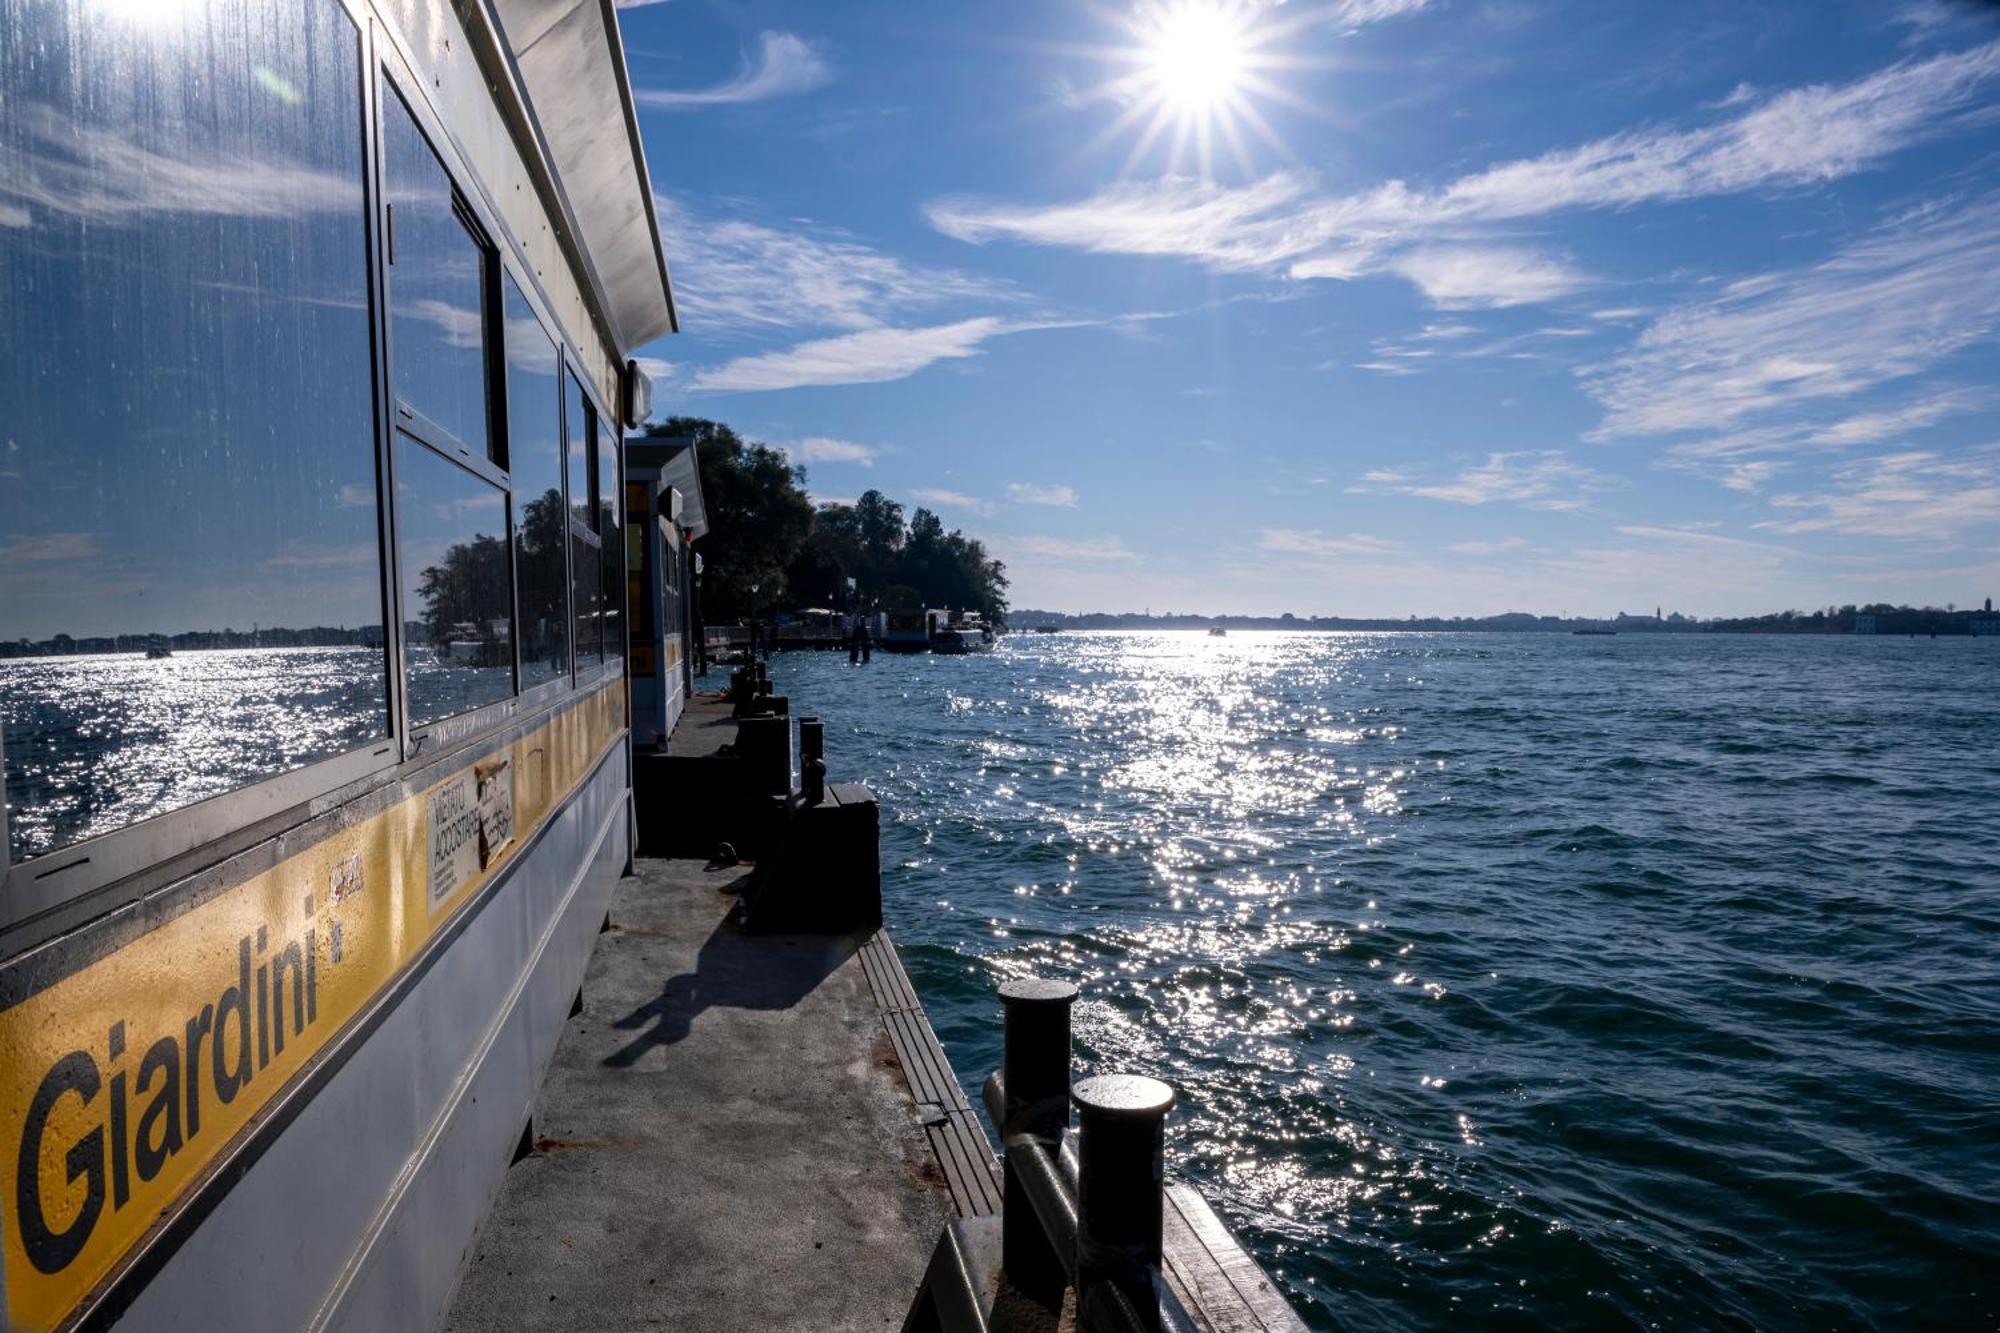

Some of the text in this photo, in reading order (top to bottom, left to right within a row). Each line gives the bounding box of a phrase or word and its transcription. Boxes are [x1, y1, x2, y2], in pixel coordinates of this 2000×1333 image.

[433, 780, 465, 826] VIETATO
[434, 807, 481, 867] ACCOSTARE
[16, 894, 317, 1275] Giardini
